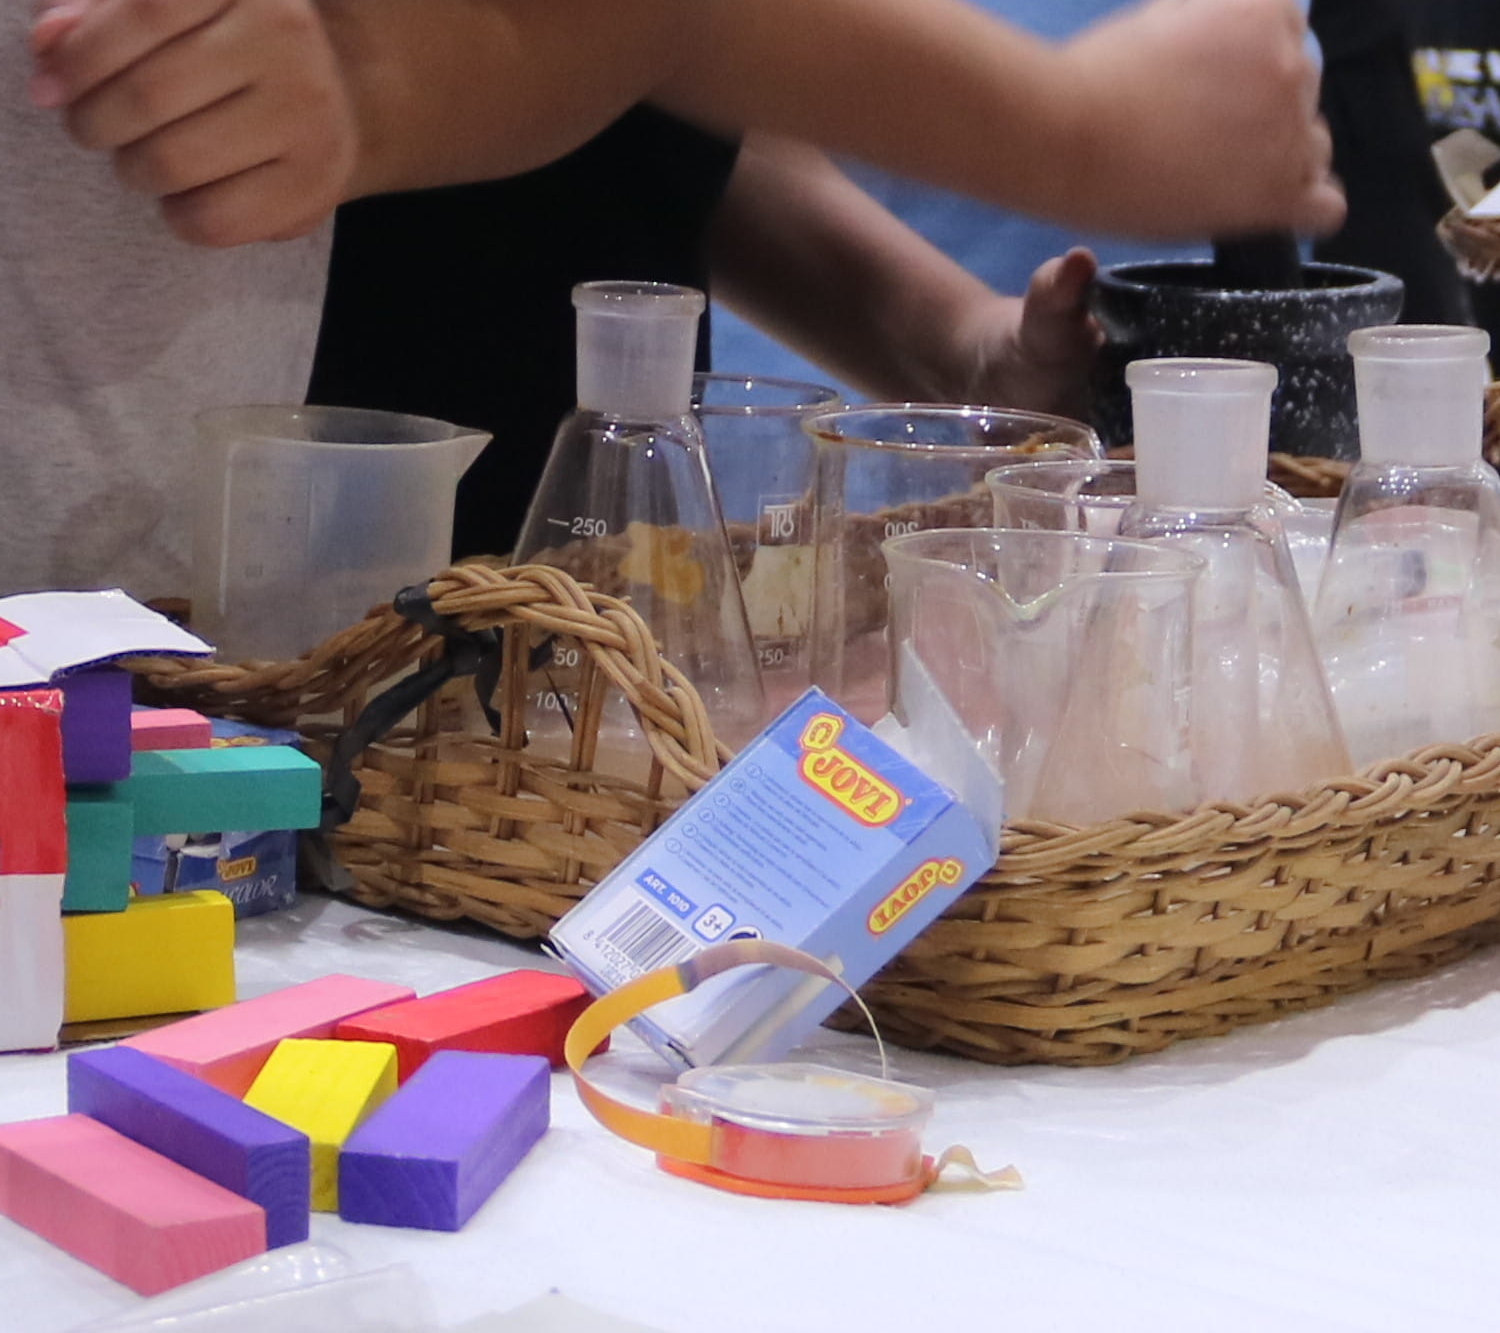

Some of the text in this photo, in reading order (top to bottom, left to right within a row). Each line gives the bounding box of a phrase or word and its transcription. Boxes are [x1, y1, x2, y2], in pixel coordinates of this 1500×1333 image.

[571, 517, 607, 537] 250
[553, 647, 579, 667] 50
[814, 756, 891, 819] JOVI
[643, 874, 690, 913] ART. 1010
[875, 867, 935, 926] JOVI
[703, 914, 723, 933] 3+
